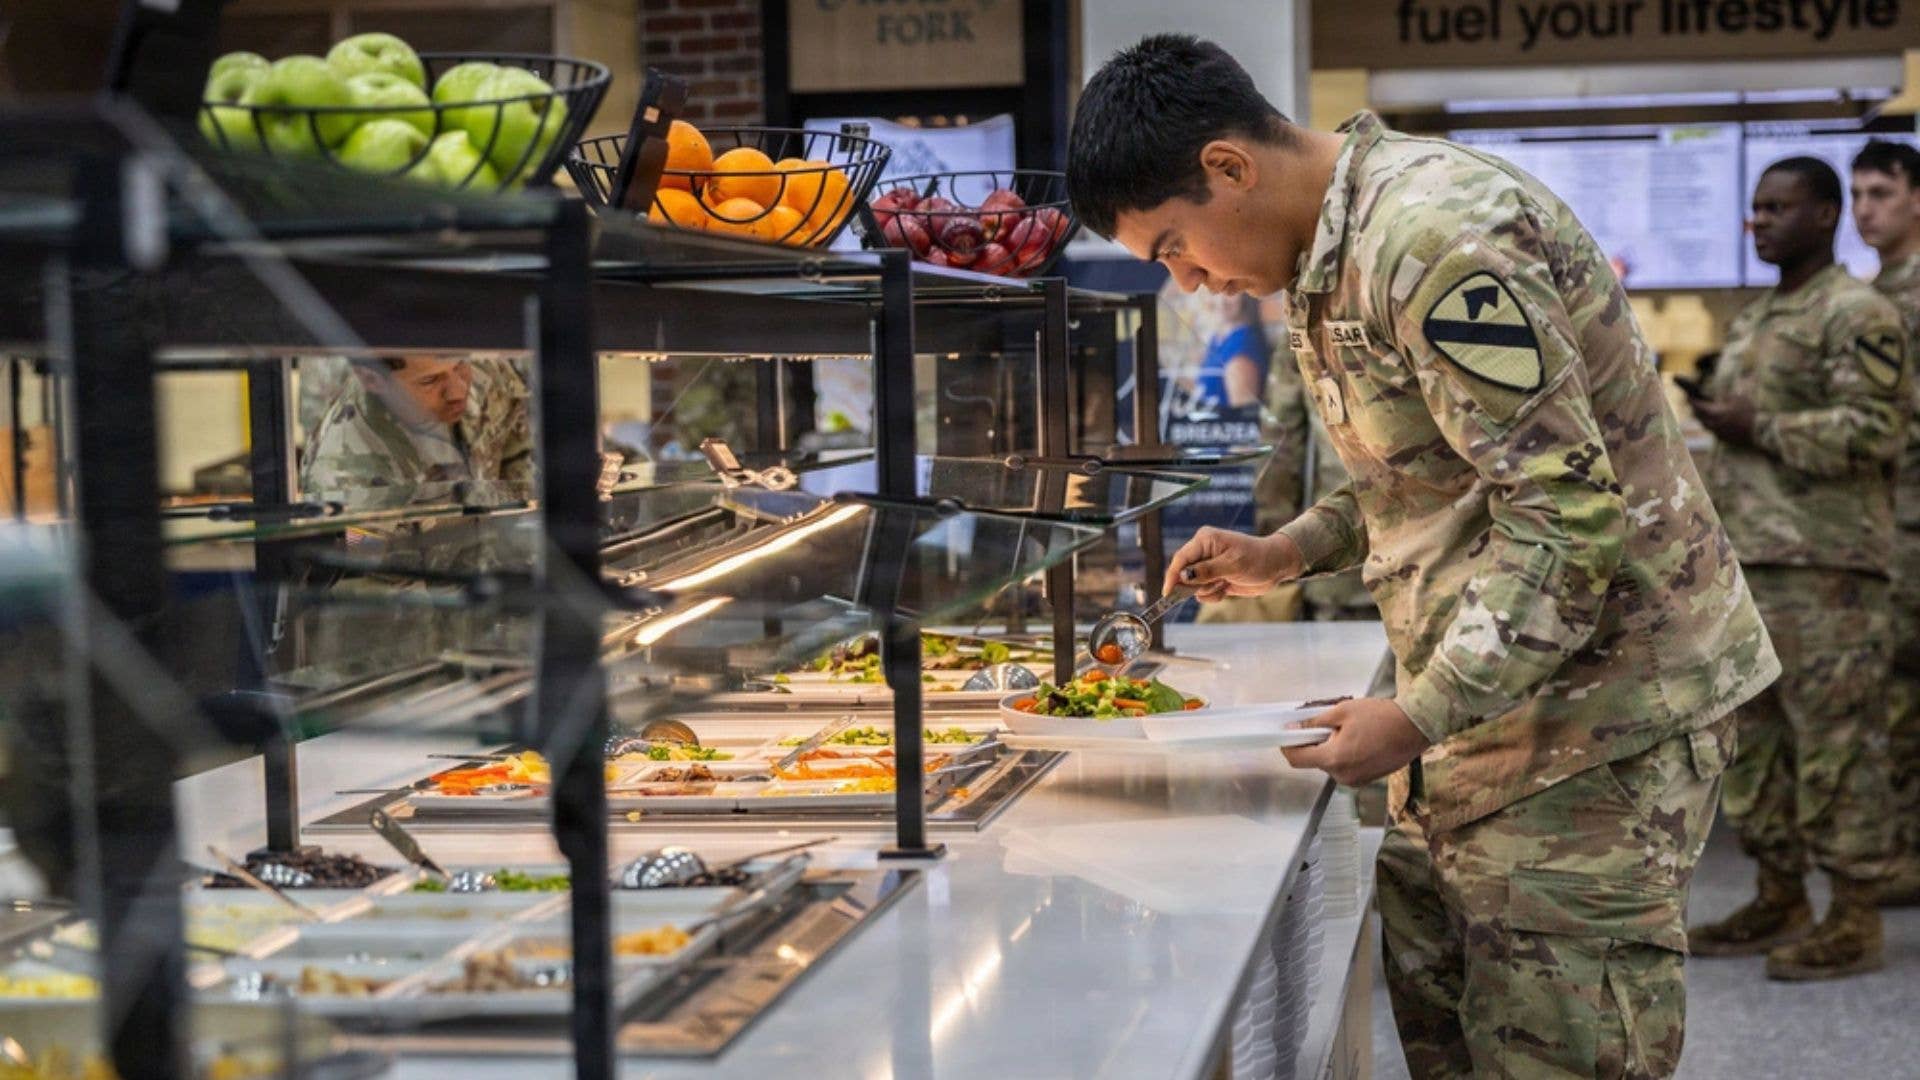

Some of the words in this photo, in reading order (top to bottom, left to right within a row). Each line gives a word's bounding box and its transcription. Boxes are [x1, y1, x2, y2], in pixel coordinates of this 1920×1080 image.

[876, 10, 975, 45] FORK
[1397, 0, 1500, 44] fuel
[1516, 0, 1643, 52] your
[1660, 0, 1898, 41] lifestyle
